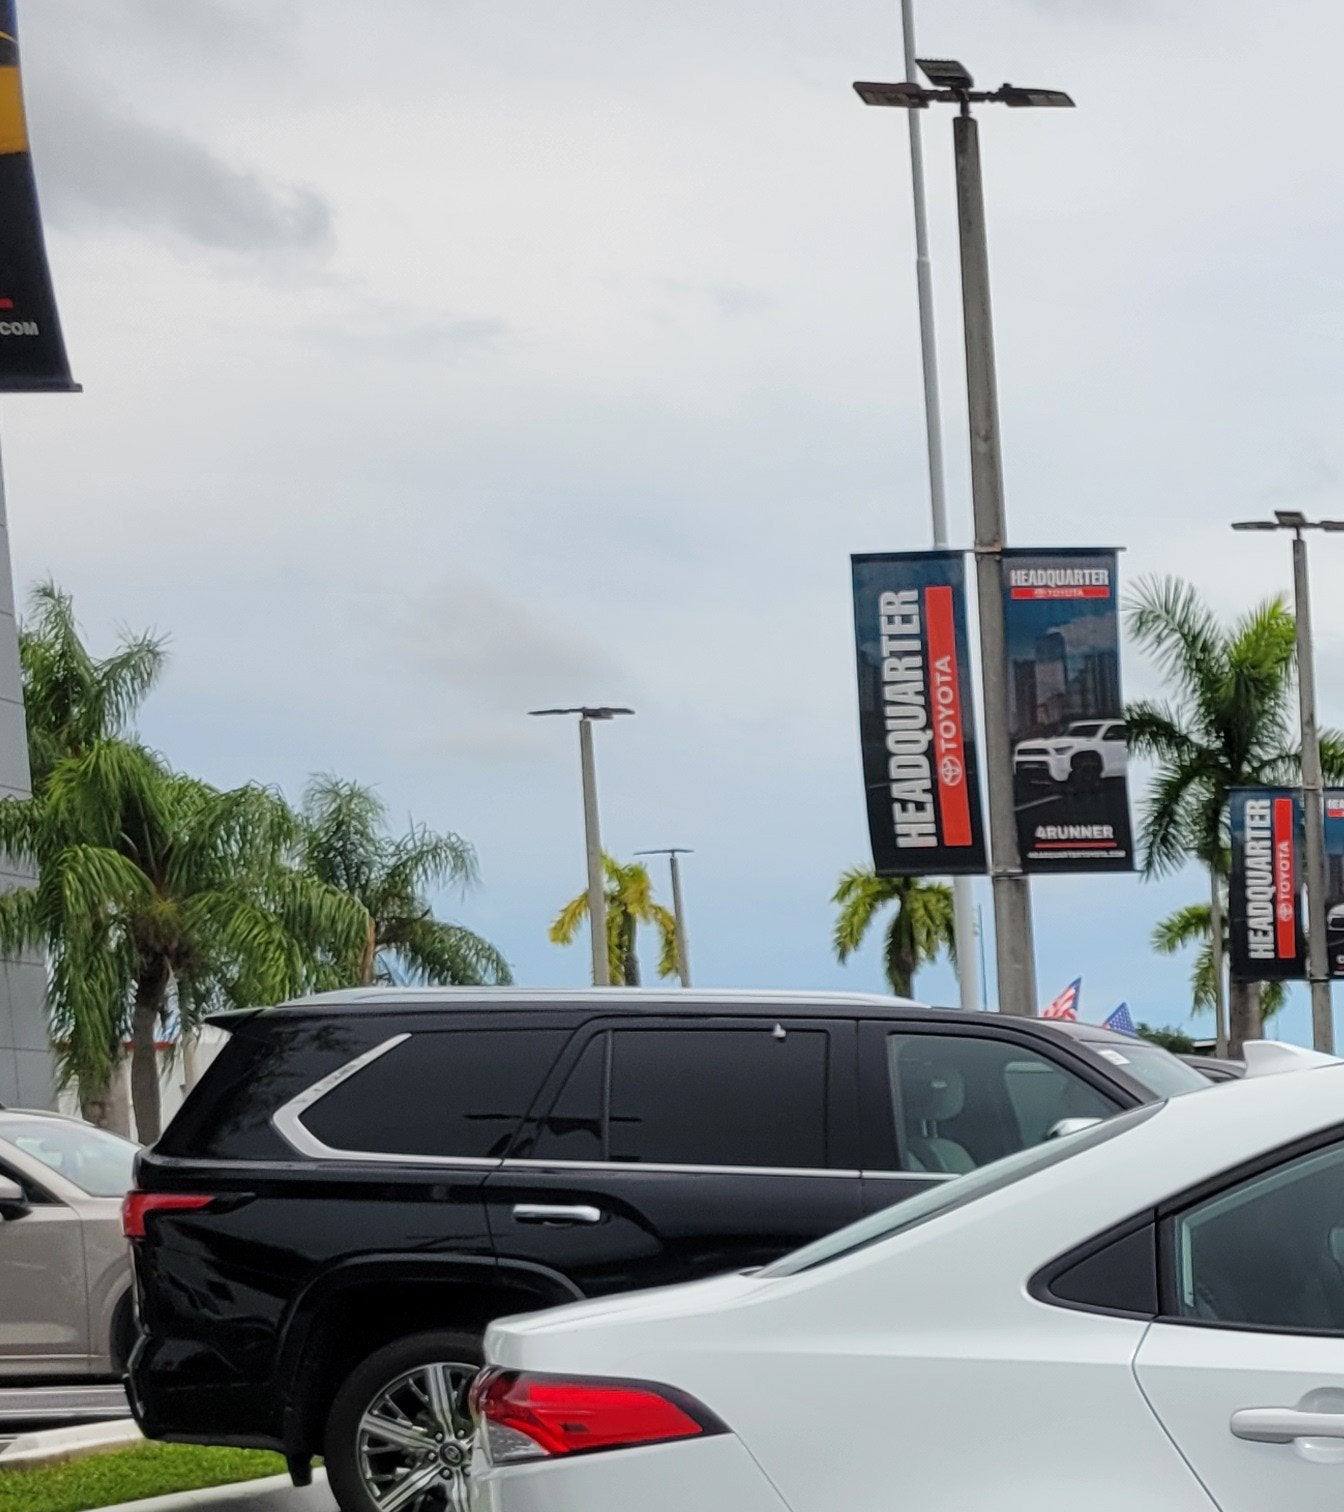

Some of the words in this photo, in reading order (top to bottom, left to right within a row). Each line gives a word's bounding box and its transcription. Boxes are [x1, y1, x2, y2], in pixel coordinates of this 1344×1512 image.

[1010, 569, 1109, 587] HEADQUARTER
[878, 588, 938, 848] HEADQUARTER
[936, 655, 959, 753] TOYOTA
[1035, 825, 1114, 839] 4RUNNER
[1279, 840, 1290, 899] TOYOTA
[1245, 799, 1276, 959] HEADQUARTER
